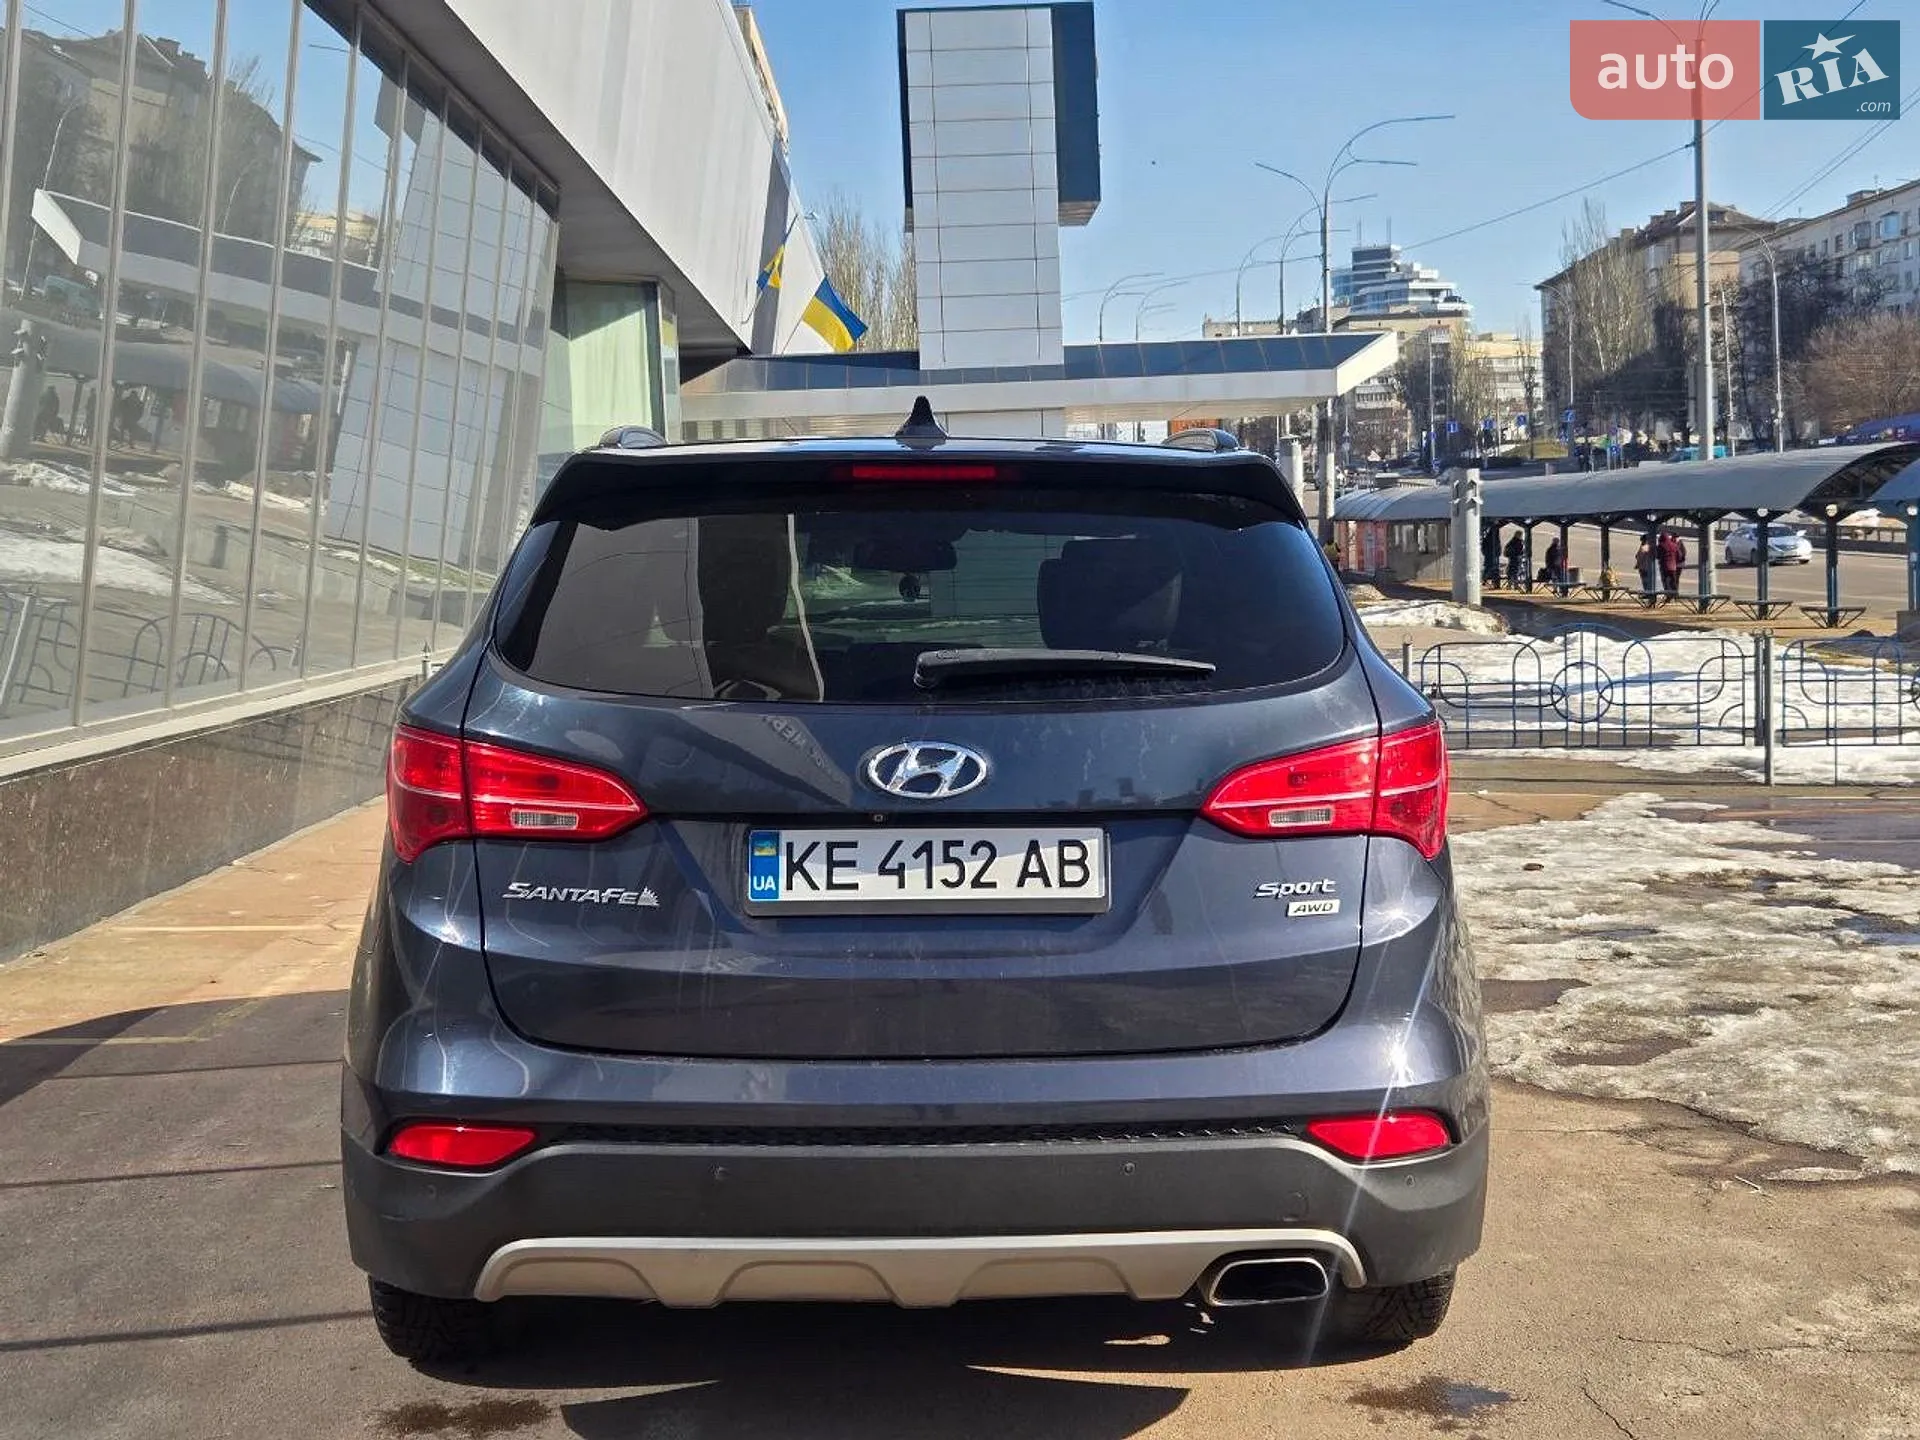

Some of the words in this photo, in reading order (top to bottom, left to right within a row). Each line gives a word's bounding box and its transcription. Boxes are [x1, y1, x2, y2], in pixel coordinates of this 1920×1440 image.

[785, 840, 859, 891] KE
[877, 839, 998, 889] 4152
[1016, 838, 1091, 888] AB
[753, 875, 776, 891] UA
[1255, 879, 1337, 898] Sport
[1293, 903, 1334, 914] AWD
